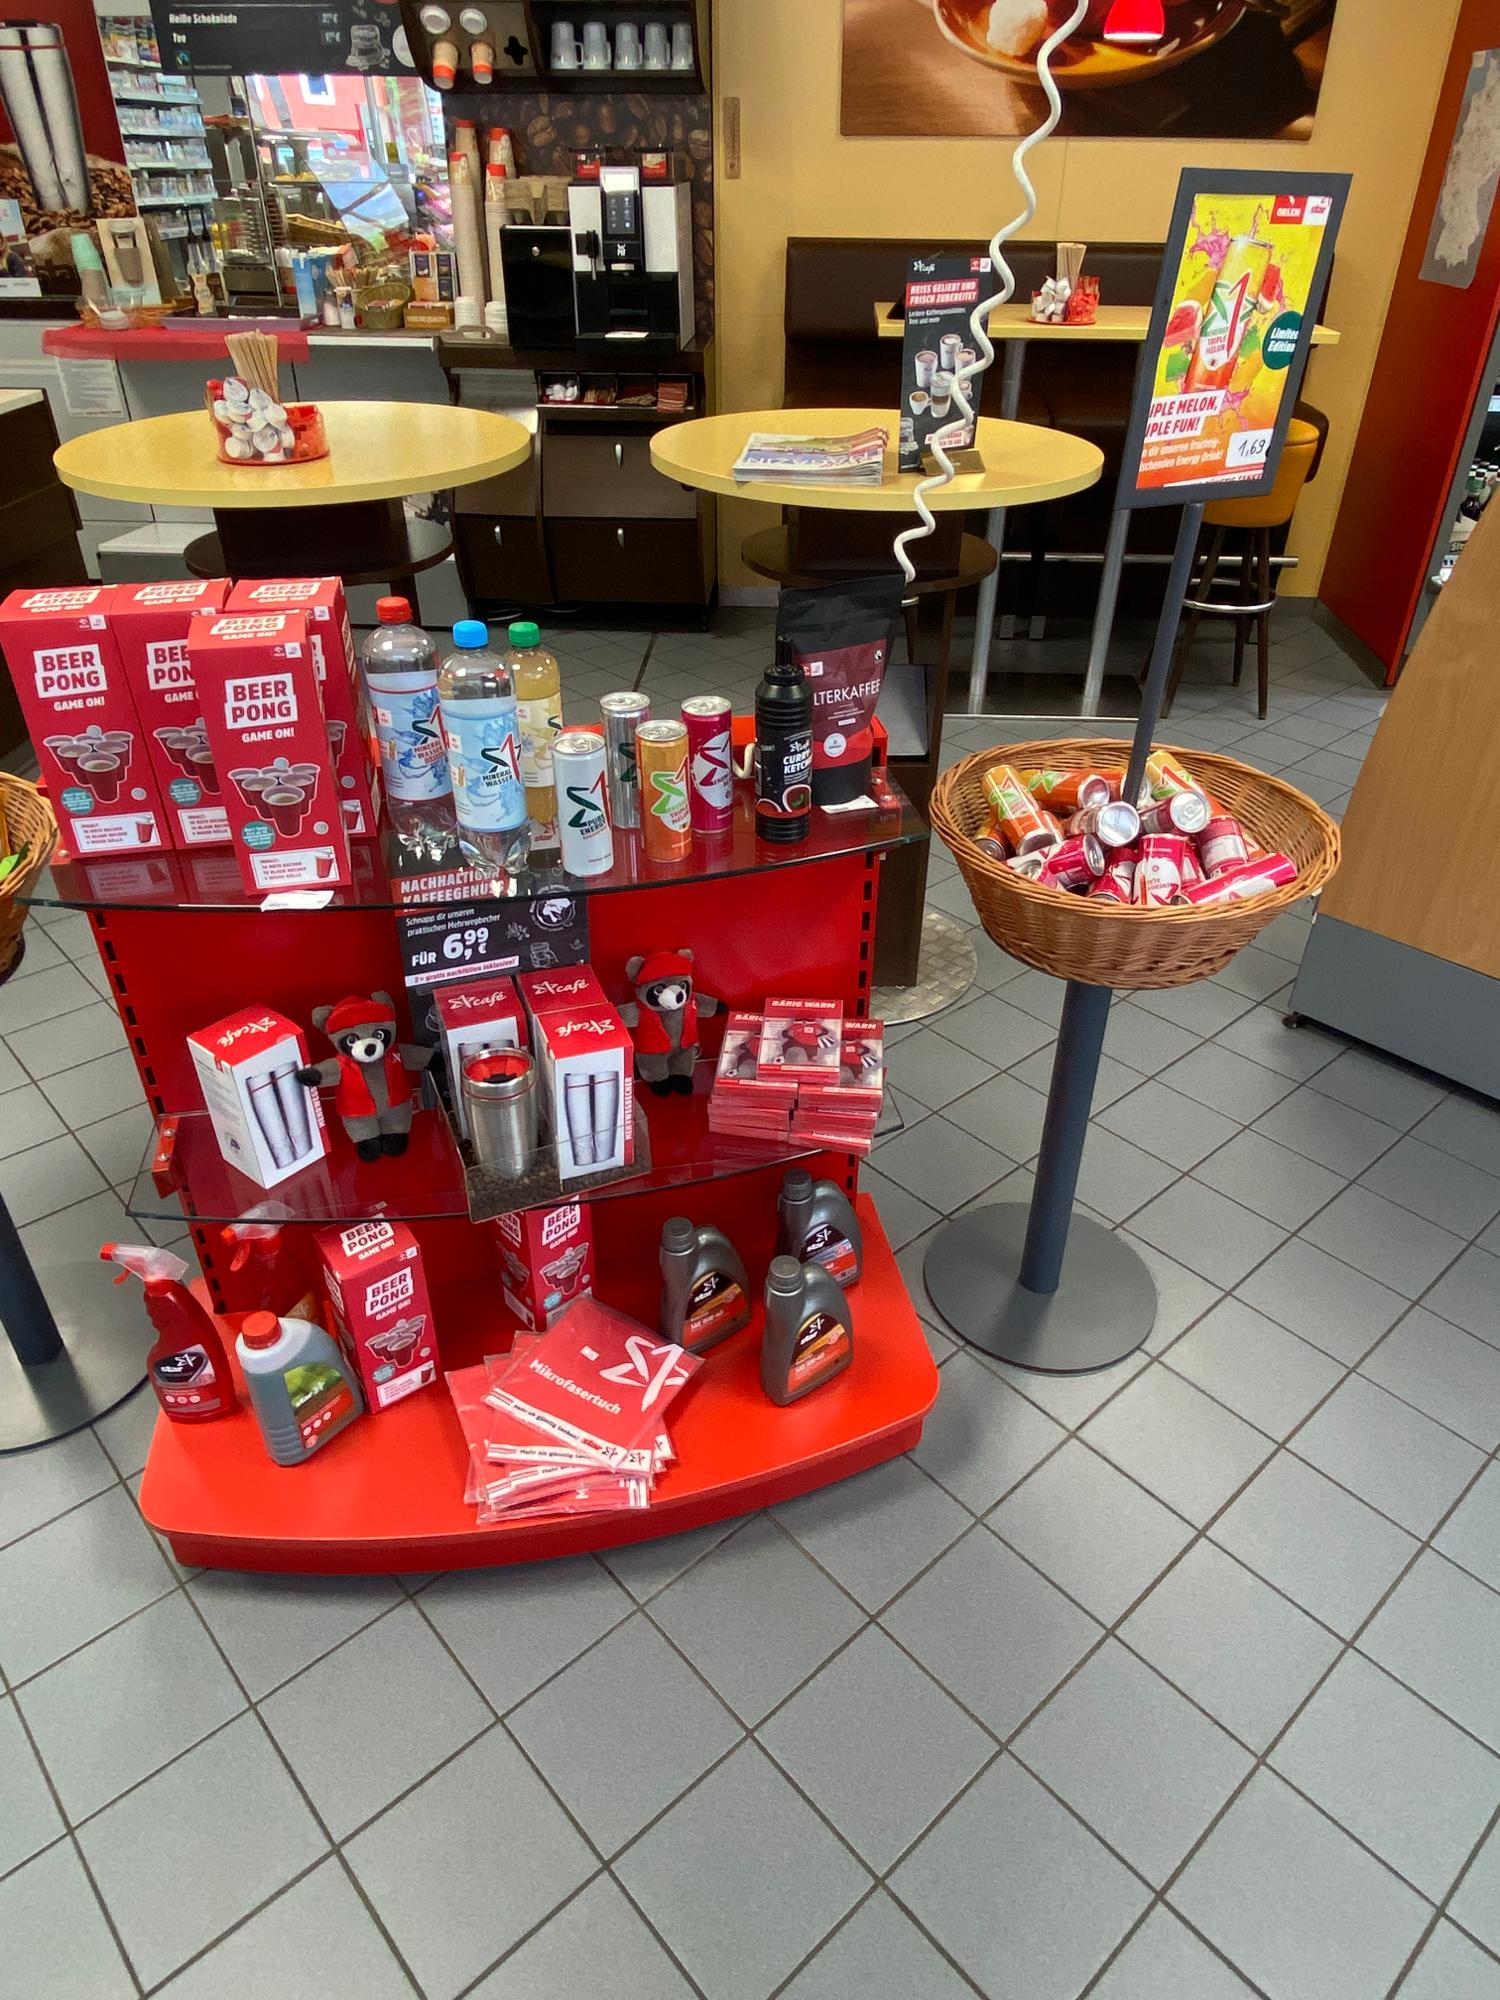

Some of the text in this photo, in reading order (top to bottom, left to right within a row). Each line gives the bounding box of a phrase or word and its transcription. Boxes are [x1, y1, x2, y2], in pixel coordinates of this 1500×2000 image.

[193, 13, 238, 24] Schokolade
[1276, 208, 1301, 218] ORLEN
[910, 281, 976, 295] HEISS GELIEBT UND
[909, 291, 977, 305] FRISCH ZUBEREITET
[1267, 340, 1296, 353] Edition
[1149, 396, 1218, 418] IPLE MELON,
[1146, 416, 1200, 437] IPLE FUN!
[1238, 439, 1266, 457] 1,69
[41, 651, 95, 673] BEER
[153, 645, 190, 665] BEE
[41, 670, 101, 693] PONG
[153, 665, 195, 685] PON
[164, 691, 194, 704] GAME
[233, 680, 288, 703] BEER
[813, 679, 881, 706] LTERKAFFEE
[53, 696, 105, 712] GAME ON!
[231, 700, 292, 724] PONG
[241, 727, 295, 743] GAME ON!
[482, 769, 513, 781] MINERAL
[485, 774, 513, 788] WASSER
[580, 819, 606, 836] ENERGY
[587, 813, 606, 827] PURE
[406, 908, 475, 927] Schnapp dir unseren
[407, 913, 502, 938] praktischen Mehrwegbecher
[411, 951, 438, 967] FÜR
[556, 978, 590, 994] café
[473, 991, 508, 1007] café
[771, 998, 836, 1009] BÄRIG WARM
[845, 1021, 877, 1030] WARM
[548, 1204, 577, 1228] BEER
[345, 1221, 382, 1242] BEER
[546, 1213, 577, 1241] PONG
[347, 1226, 389, 1253] PONG
[358, 1246, 381, 1261] GAME
[371, 1273, 408, 1299] BEER
[370, 1284, 409, 1312] PONG
[376, 1306, 397, 1321] GAME
[160, 1365, 183, 1373] star
[529, 1358, 622, 1415] Mikrofasertuch
